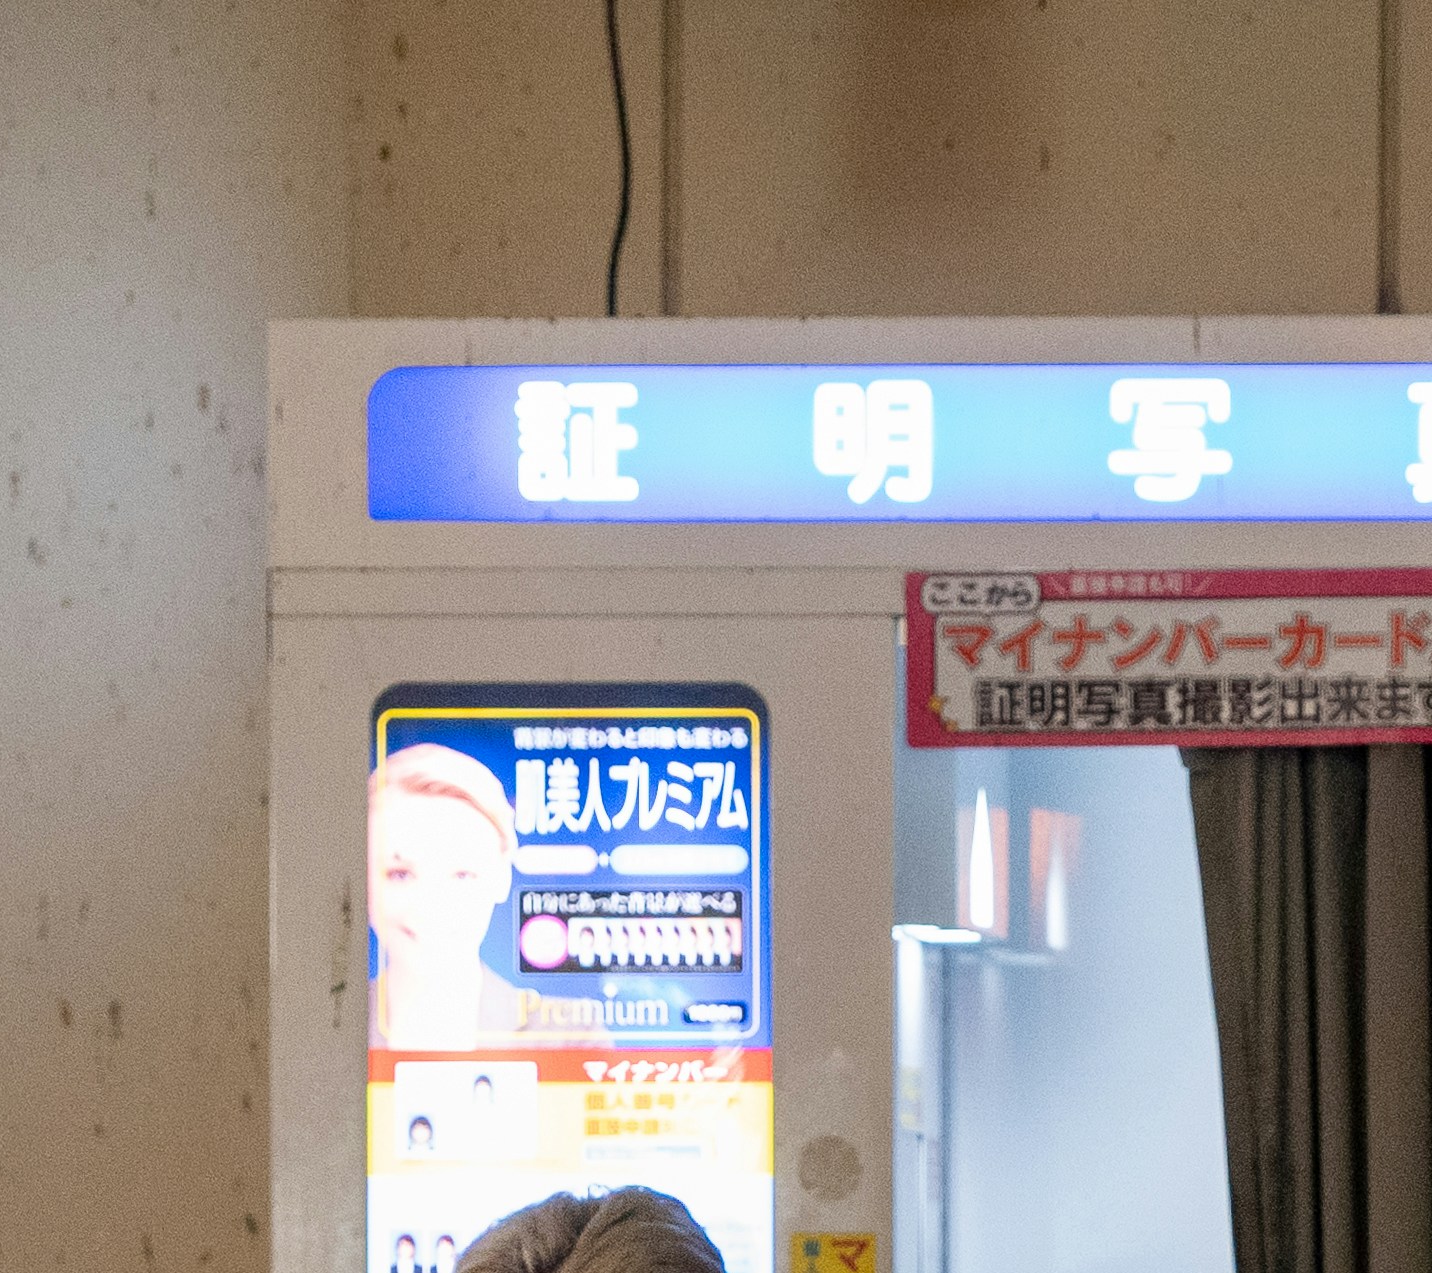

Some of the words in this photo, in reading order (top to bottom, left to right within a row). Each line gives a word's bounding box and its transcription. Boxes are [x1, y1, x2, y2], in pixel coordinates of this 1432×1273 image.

[929, 580, 1034, 606] ここから
[515, 983, 670, 1030] Premium
[582, 1060, 729, 1083] マイナンバー
